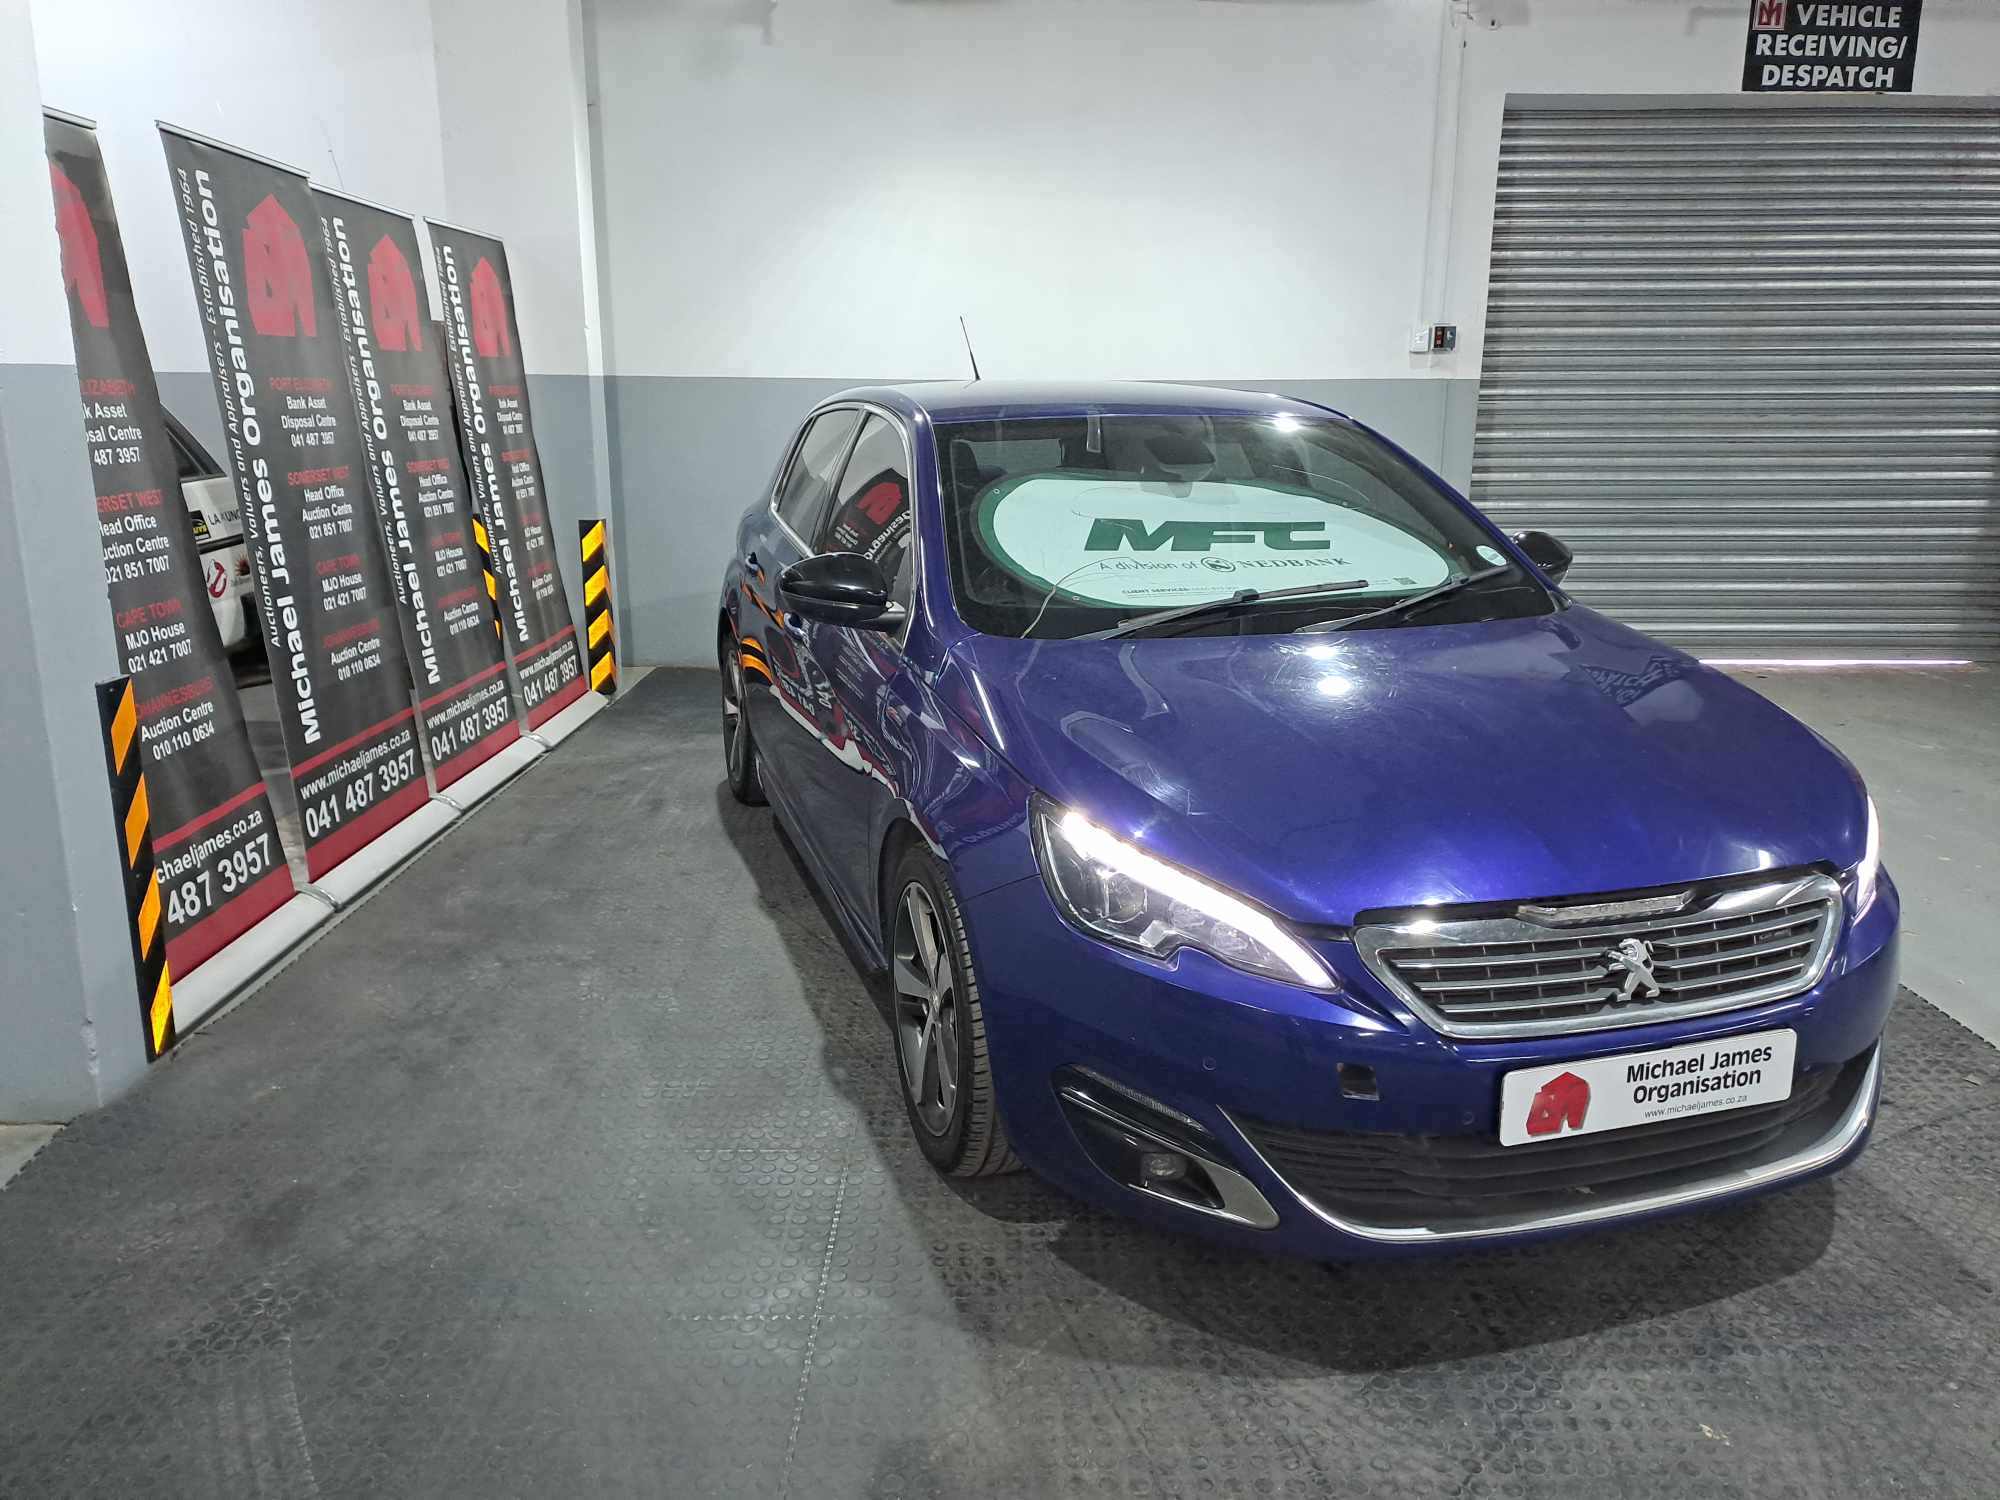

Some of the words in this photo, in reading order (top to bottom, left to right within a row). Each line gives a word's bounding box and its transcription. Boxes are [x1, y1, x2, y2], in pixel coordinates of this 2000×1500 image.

[1797, 4, 1902, 28] VEHICLE
[1756, 34, 1908, 59] RECEIVING/
[1761, 65, 1894, 88] DESPATCH
[177, 167, 193, 214] 1964
[190, 220, 217, 326] Established
[195, 168, 261, 447] Organisation
[332, 216, 388, 440] Organisation
[443, 245, 486, 435] Organisation
[214, 341, 240, 434] Appraisers
[286, 396, 307, 410] Bank
[95, 402, 127, 418] Asset
[281, 414, 315, 431] Disposal
[316, 414, 336, 427] Centre
[108, 424, 142, 441] Centre
[290, 433, 304, 447] 041
[363, 431, 377, 462] and
[465, 428, 477, 453] and
[94, 448, 112, 466] 487
[116, 446, 141, 464] 3957
[231, 438, 246, 472] and
[304, 487, 324, 503] Head
[324, 485, 344, 499] Office
[371, 465, 388, 516] Valuers
[472, 455, 486, 499] Valuers
[481, 442, 507, 531] James
[240, 477, 258, 539] Valuers
[302, 506, 331, 522] Auction
[331, 502, 353, 516] Centre
[381, 450, 413, 554] James
[124, 514, 157, 532] Office
[253, 458, 290, 585] James
[309, 525, 322, 540] 021
[323, 522, 337, 536] 851
[1084, 518, 1331, 551] MFC
[136, 535, 169, 553] Centre
[105, 565, 123, 584] 021
[124, 560, 144, 579] 851
[146, 555, 169, 574] 7007
[1099, 561, 1109, 571] A
[1115, 560, 1178, 571] division
[1181, 559, 1199, 570] of
[1237, 557, 1353, 568] NEDBANK
[256, 546, 280, 648] Auctioneers,
[322, 577, 338, 592] MJO
[339, 573, 362, 587] House
[498, 538, 529, 642] Michael
[323, 597, 337, 611] 021
[337, 592, 351, 606] 421
[125, 629, 149, 650] MJO
[150, 622, 185, 642] House
[402, 562, 440, 685] Michael
[128, 654, 147, 673] 021
[148, 646, 168, 666] 421
[169, 638, 192, 659] 7007
[331, 646, 357, 665] Auction
[358, 638, 380, 654] Centre
[277, 595, 321, 744] Michael
[523, 678, 543, 707] 041
[544, 667, 559, 694] 487
[560, 655, 578, 683] 3957
[141, 715, 181, 742] Auction
[182, 701, 214, 723] Centre
[431, 727, 457, 761] 041
[460, 713, 480, 743] 487
[482, 696, 509, 730] 3957
[152, 739, 171, 760] 010
[172, 731, 191, 751] 110
[192, 720, 214, 742] 0634
[300, 729, 411, 800] www.michaeljames.co.za
[305, 794, 341, 838] 041
[345, 772, 374, 812] 487
[378, 749, 415, 792] 3957
[168, 870, 212, 924] 487
[218, 832, 270, 893] 3957
[1626, 1053, 1705, 1083] Michael
[1709, 1045, 1773, 1071] James
[1632, 1067, 1762, 1104] Organisation
[1644, 1094, 1747, 1119] www.michaeljames.co.za
